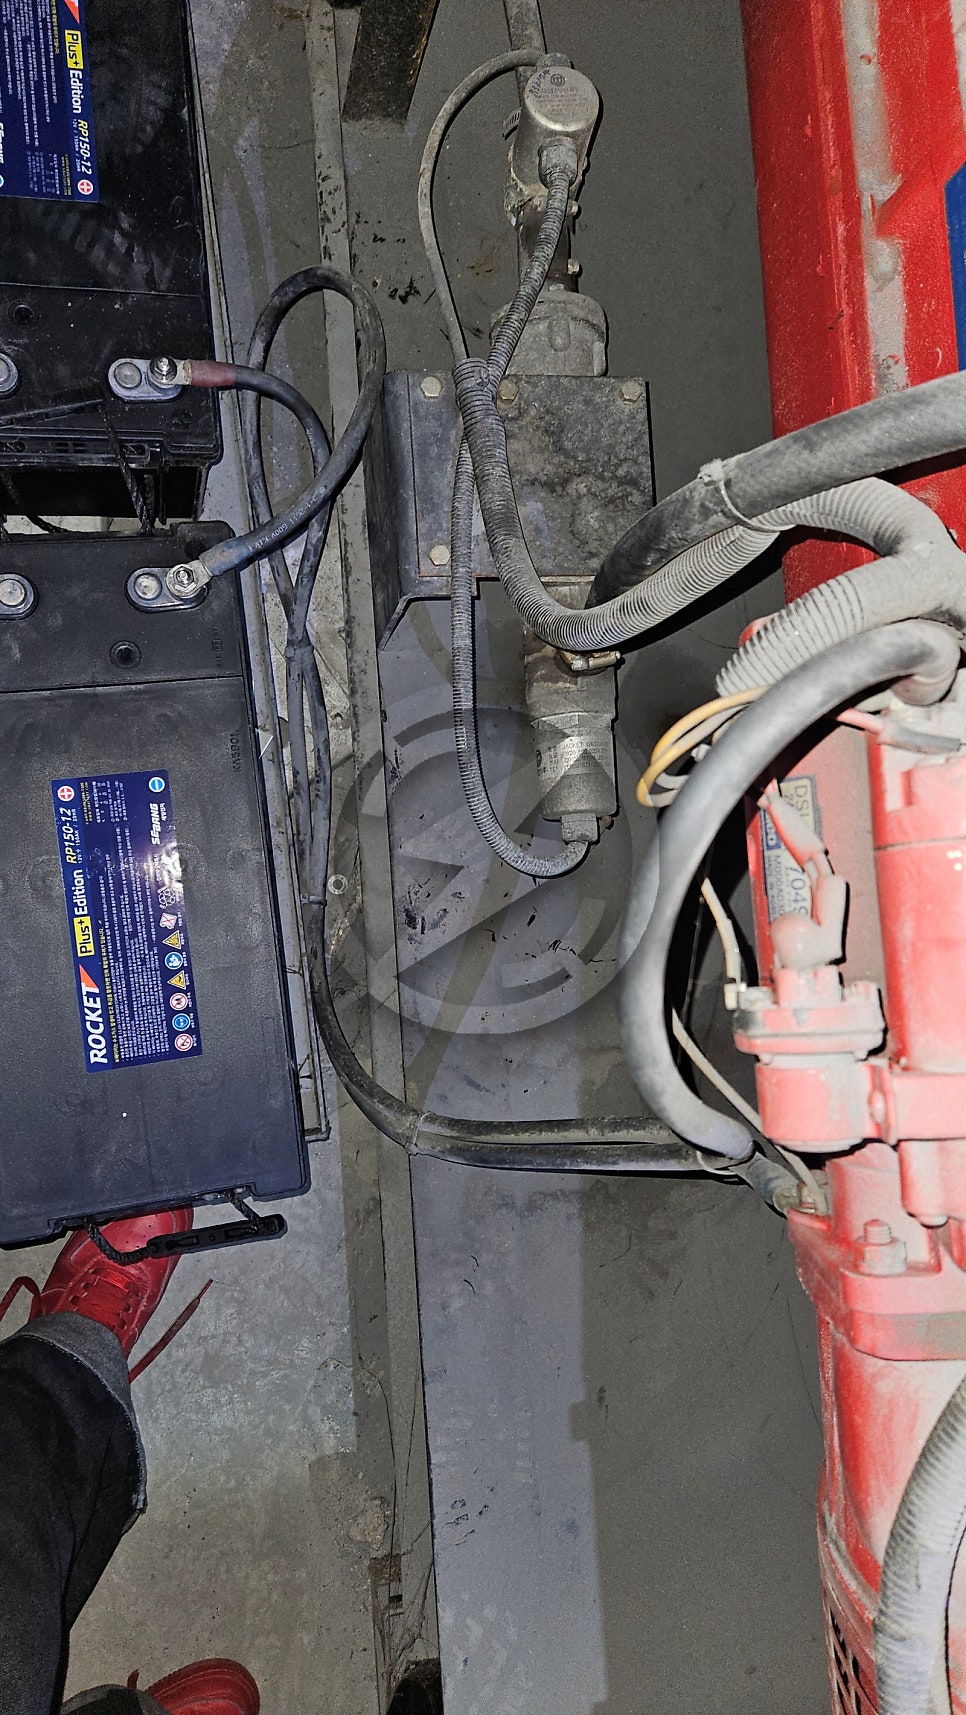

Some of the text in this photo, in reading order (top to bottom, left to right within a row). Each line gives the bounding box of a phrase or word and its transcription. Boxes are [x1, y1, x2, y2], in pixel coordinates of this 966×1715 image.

[67, 32, 84, 113] Plus+ Edition
[78, 119, 92, 175] RP150-12
[59, 807, 77, 864] RP150-12
[149, 803, 161, 845] SEBANG
[71, 869, 92, 954] Plus+ Edition
[81, 982, 108, 1064] ROCKET
